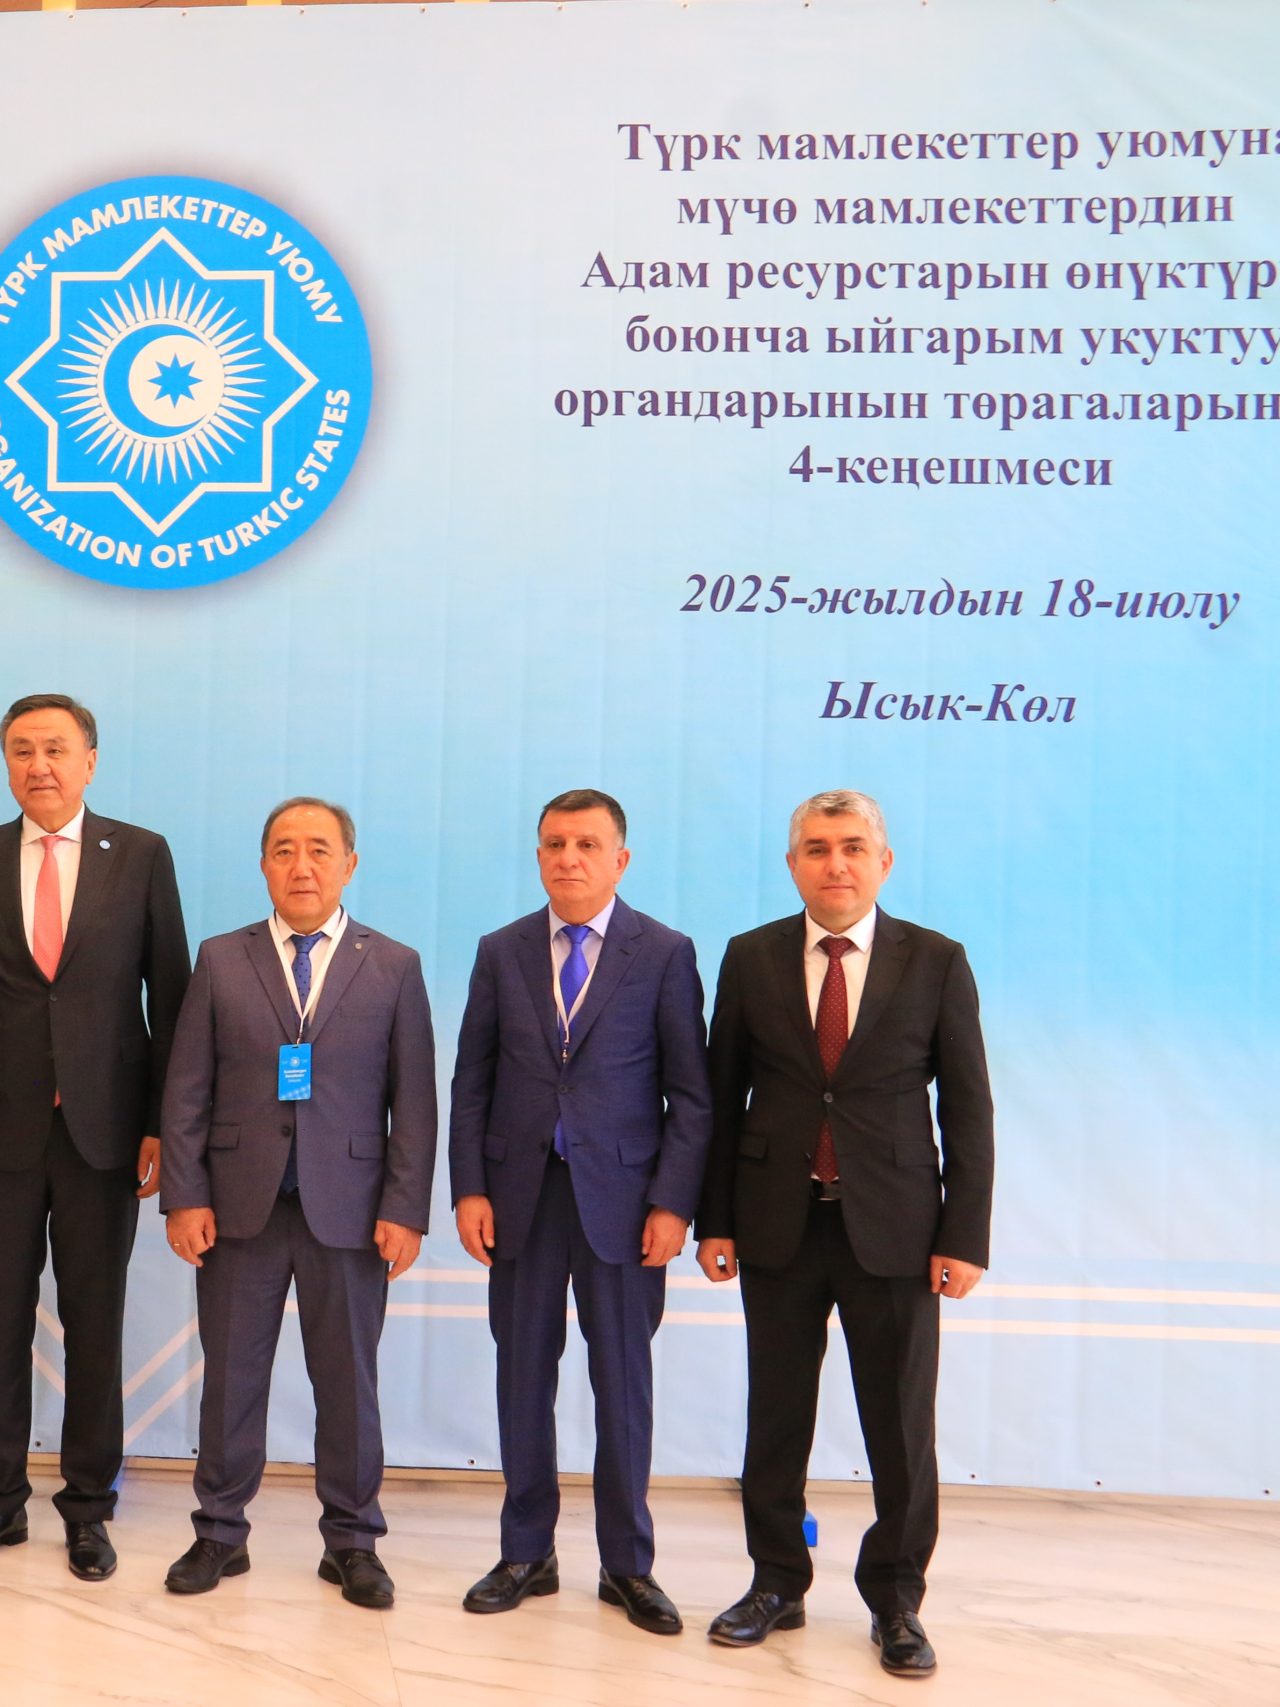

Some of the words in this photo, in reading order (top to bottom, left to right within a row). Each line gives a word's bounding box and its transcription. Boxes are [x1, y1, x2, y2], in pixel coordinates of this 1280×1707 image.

[617, 123, 742, 171] Түрк
[757, 130, 1079, 170] мамлекеттер
[1096, 128, 1280, 170] уюмун
[677, 197, 798, 235] мүчө
[814, 195, 1234, 235] мамлекеттердин
[42, 195, 267, 261] МАМЛЕКЕТТЕР
[265, 232, 344, 326] УЮМУ
[580, 250, 710, 294] Адам
[726, 261, 1049, 300] ресурстарын
[1065, 259, 1280, 301] өнүктүр
[625, 314, 810, 354] боюнча
[825, 317, 1063, 366] ыйгарым
[554, 388, 929, 430] органдарынын
[150, 542, 194, 569] OF
[197, 486, 305, 562] TURKIC
[295, 389, 352, 492] STATES
[788, 445, 1113, 490] 4-кеңешмеси
[679, 573, 1024, 617] 2025-жылдын
[1039, 578, 1241, 631] 18-июлу
[818, 680, 1077, 724] Ысык-Көл
